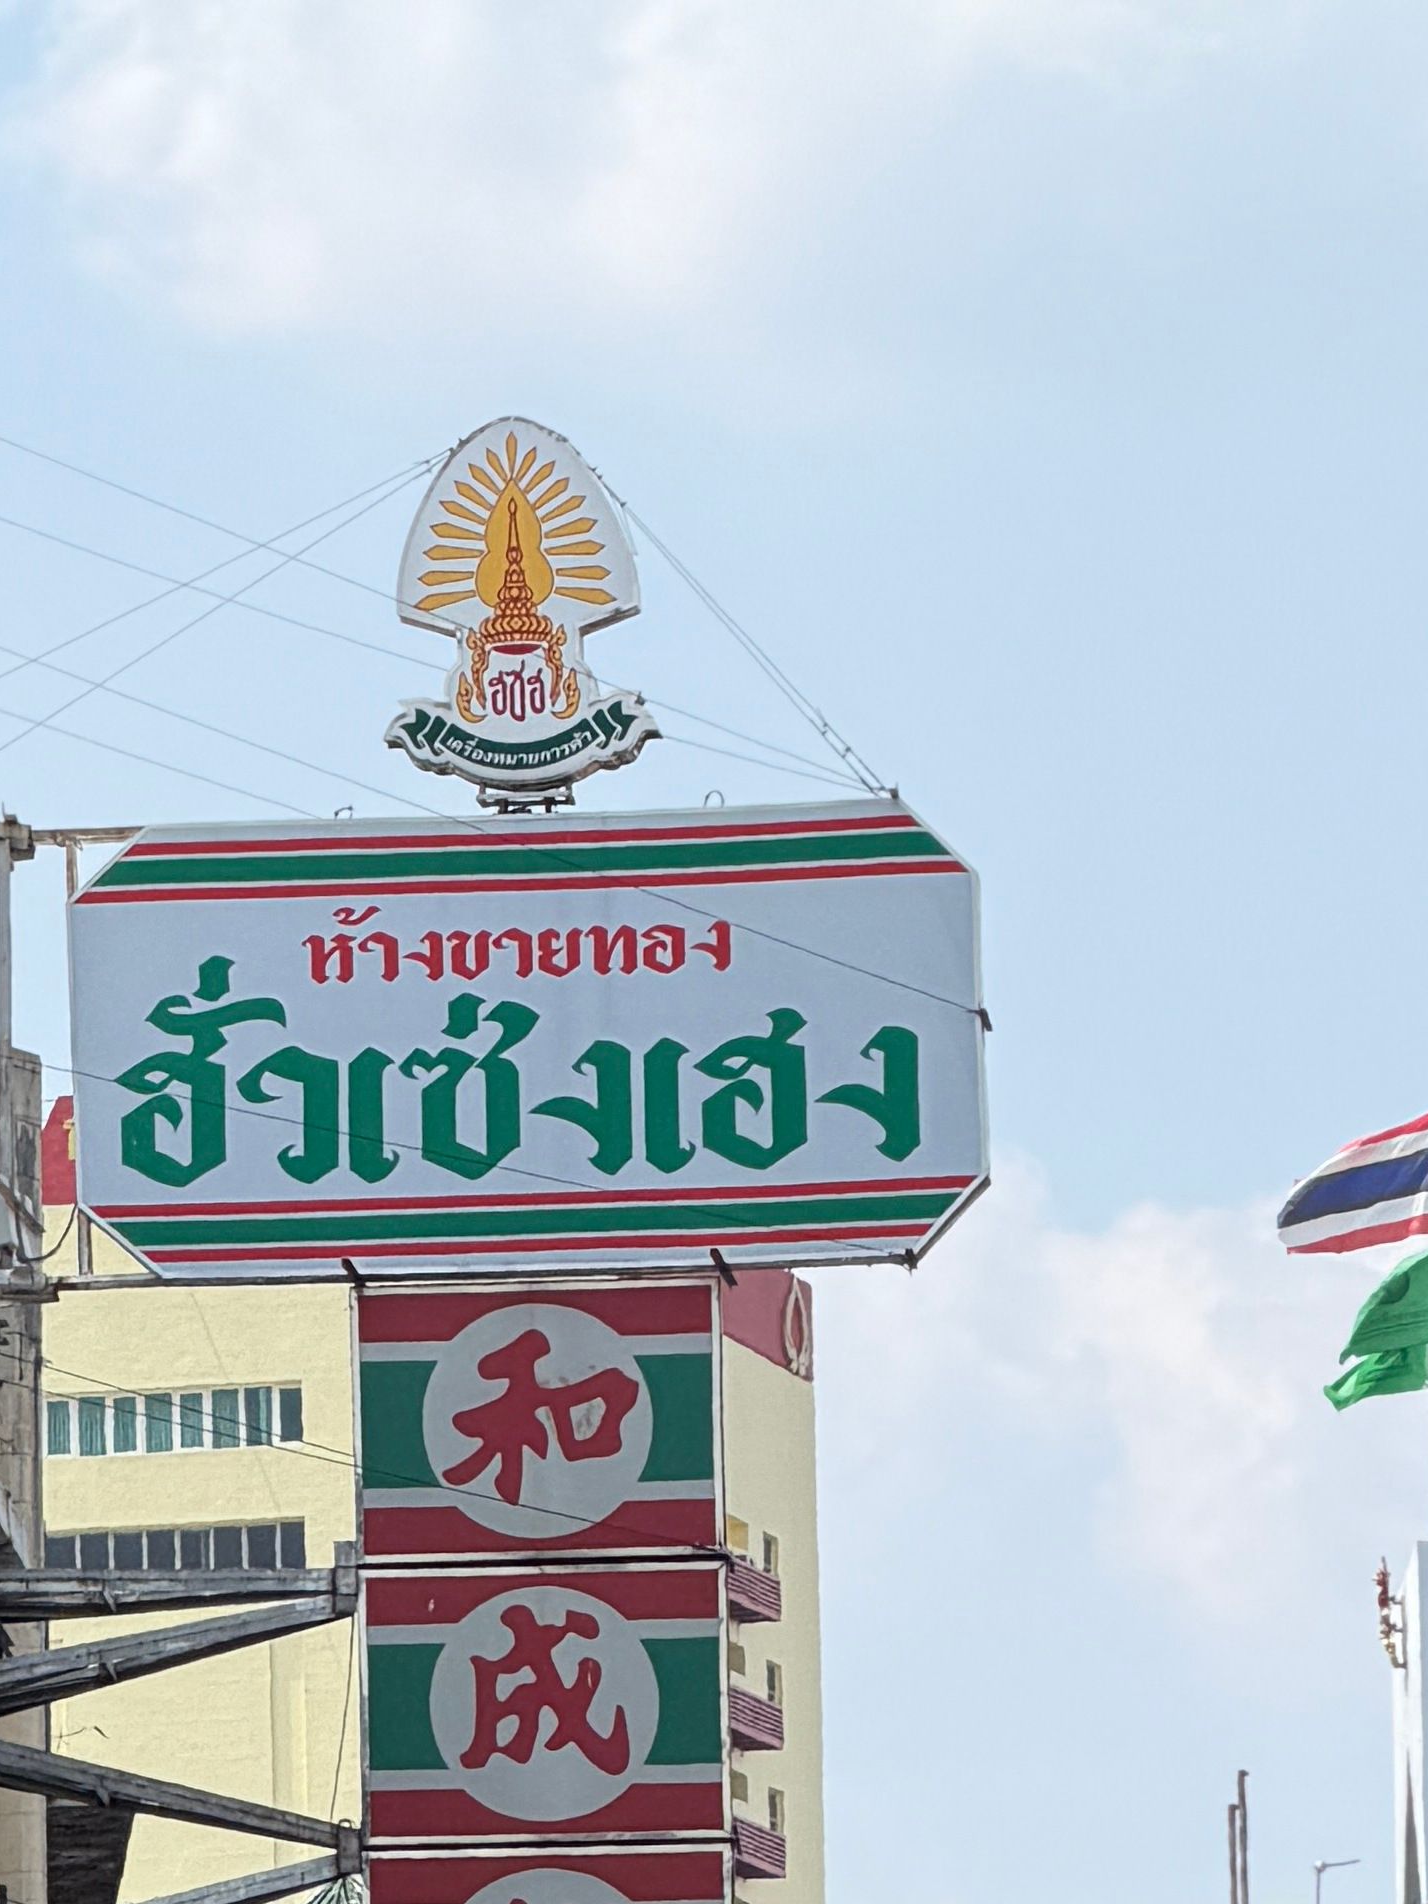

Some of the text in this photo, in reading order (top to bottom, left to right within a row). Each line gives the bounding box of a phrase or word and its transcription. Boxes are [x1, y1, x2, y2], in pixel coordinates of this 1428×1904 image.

[445, 722, 595, 766] เครื่องหมายการค้า
[303, 905, 733, 987] ห้างขายทอง
[114, 955, 921, 1188] ฮั่วเซ่งเฮง
